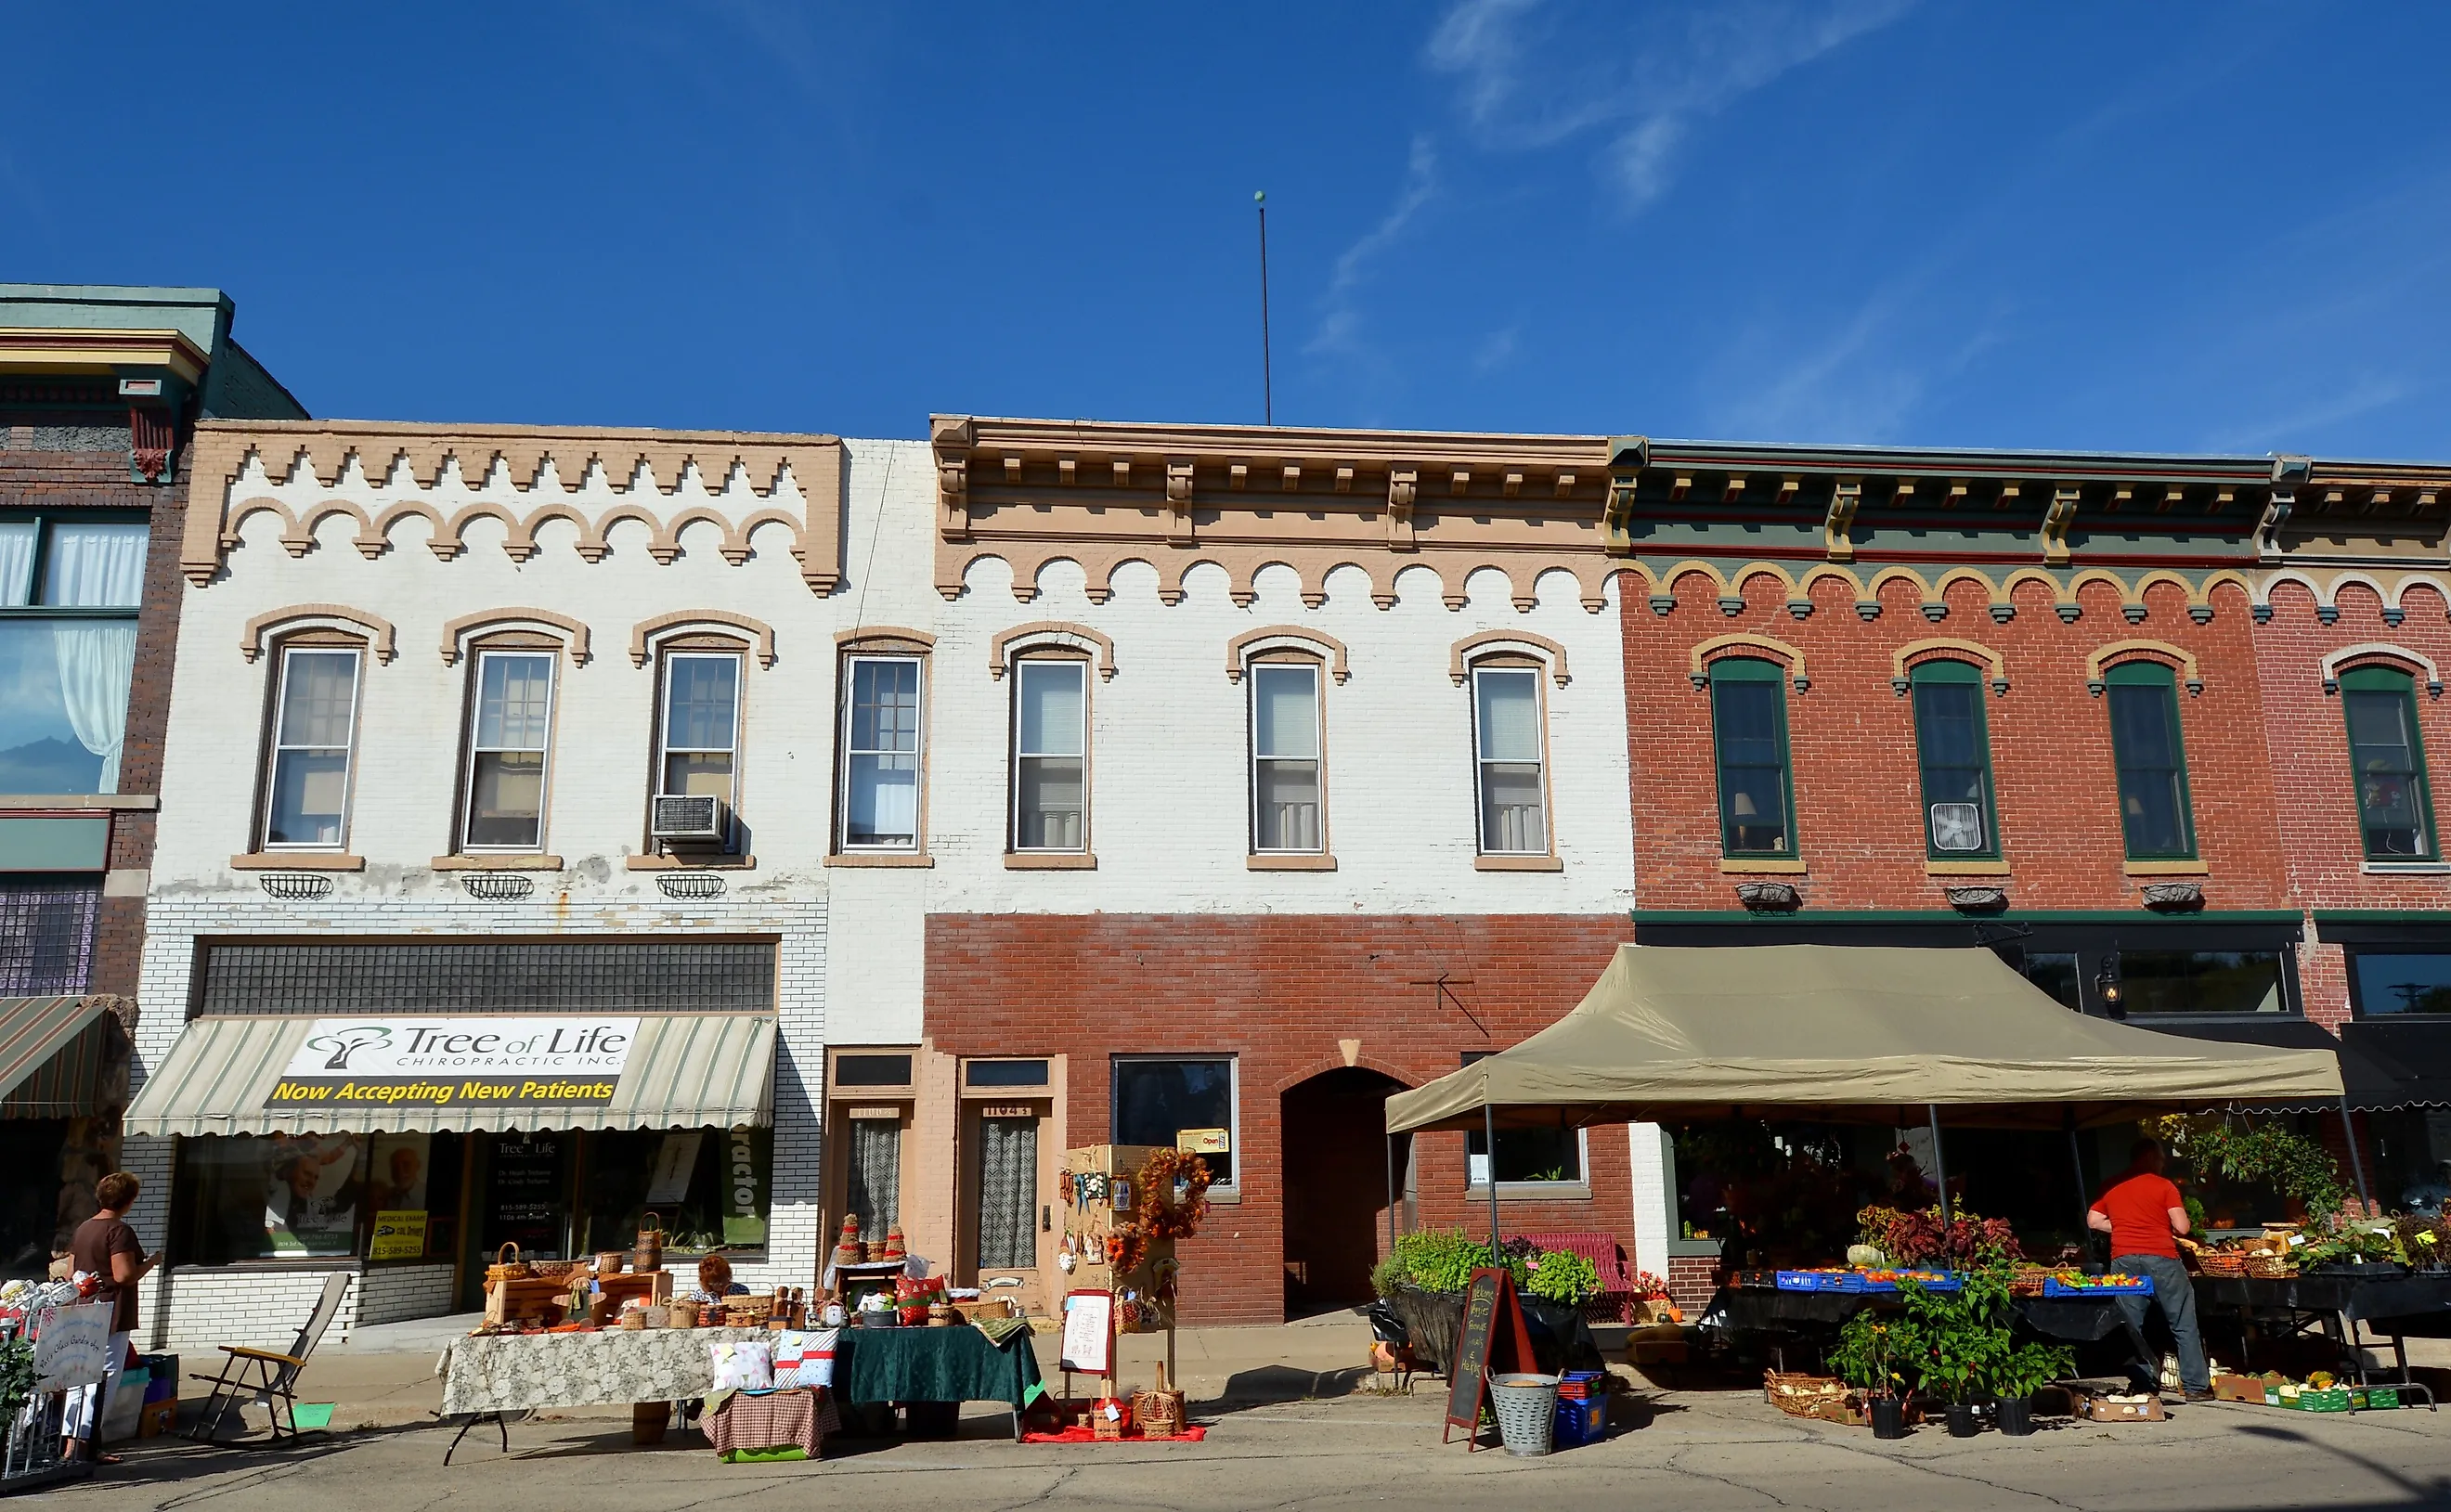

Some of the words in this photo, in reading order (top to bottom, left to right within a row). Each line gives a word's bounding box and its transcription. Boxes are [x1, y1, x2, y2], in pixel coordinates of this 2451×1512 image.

[405, 1027, 500, 1053] Tree
[504, 1034, 542, 1054] of
[546, 1026, 627, 1053] Life
[396, 1056, 564, 1066] CHIROPRACTIC
[577, 1055, 621, 1066] INC.
[273, 1082, 334, 1100] Now
[333, 1081, 454, 1104] Accepting
[459, 1081, 517, 1100] New
[519, 1080, 614, 1099] Patients
[1203, 1137, 1219, 1145] Open
[499, 1143, 524, 1154] Tree
[536, 1142, 555, 1154] Life
[372, 1246, 421, 1254] 815-589-5255
